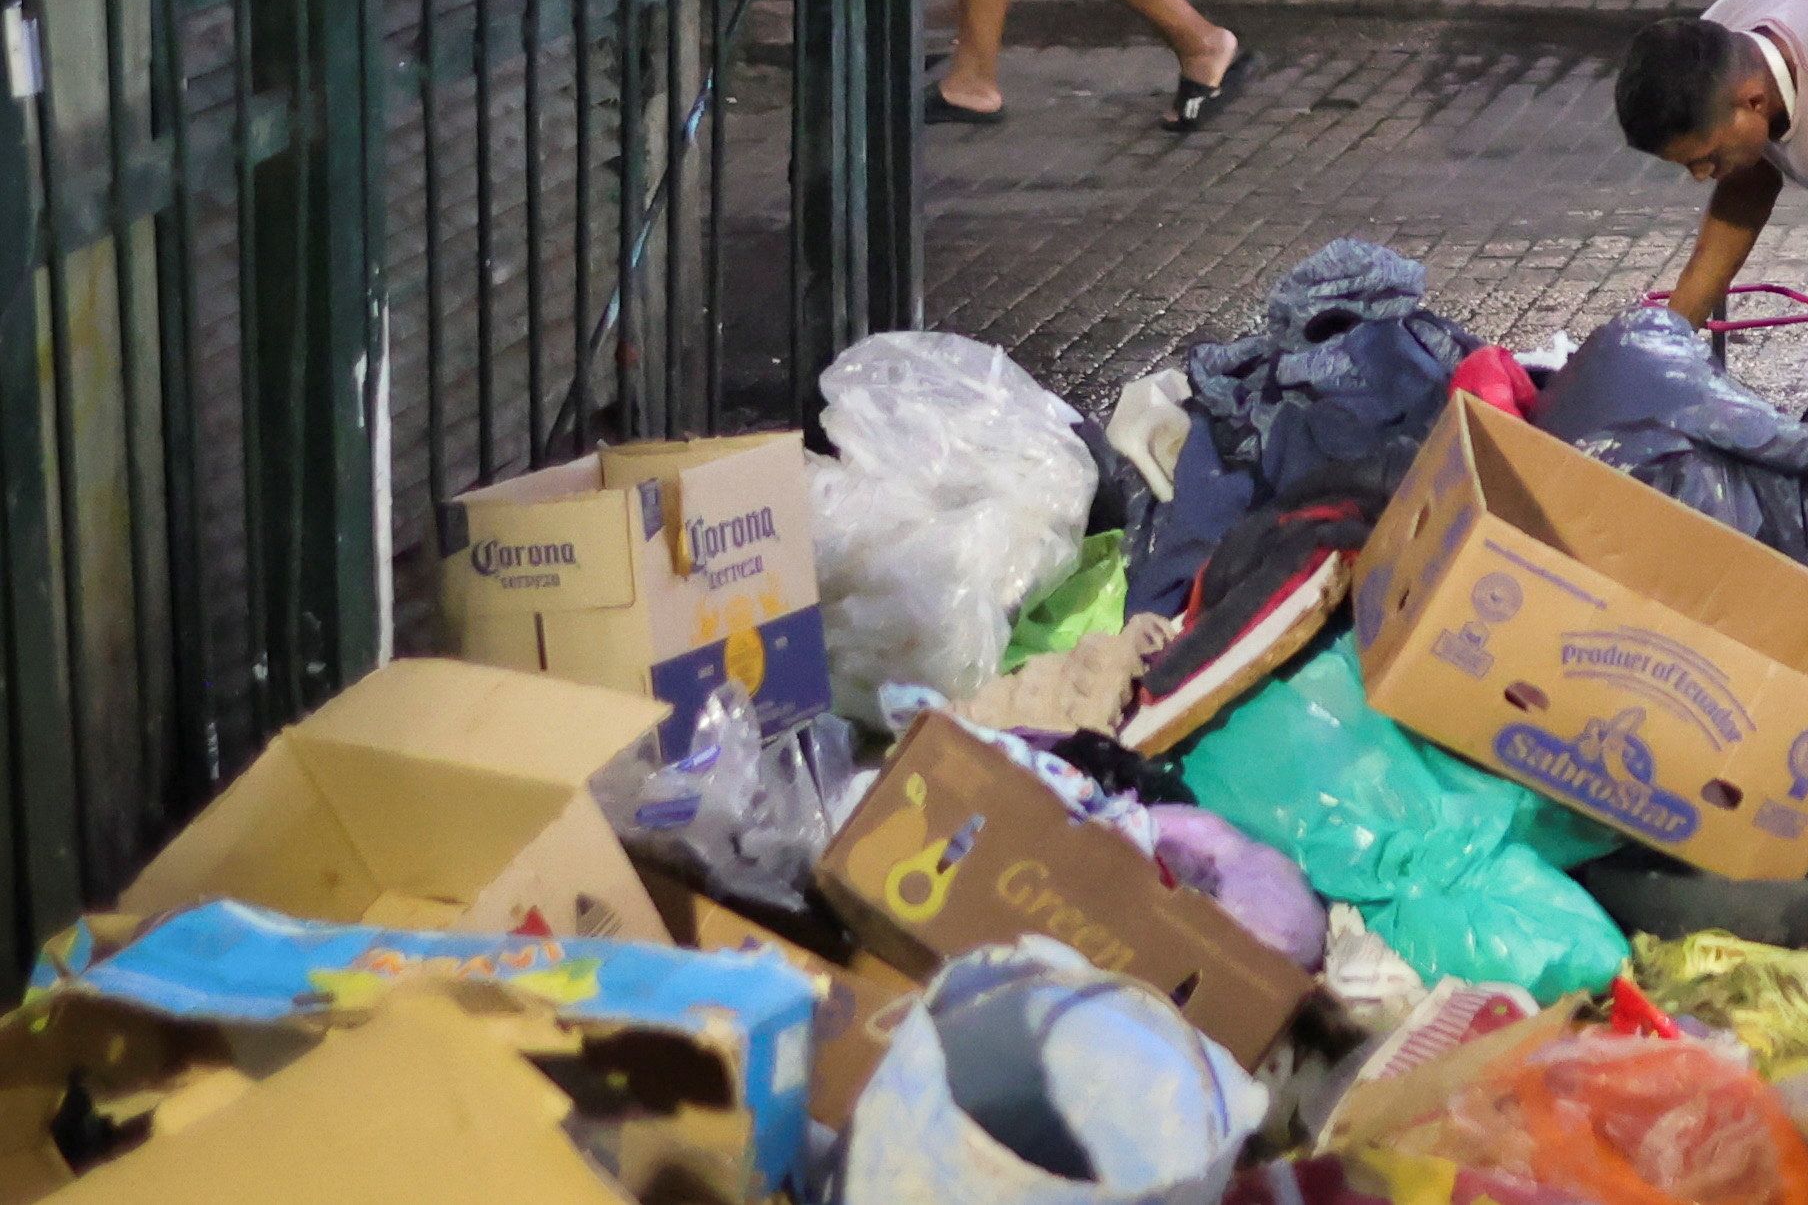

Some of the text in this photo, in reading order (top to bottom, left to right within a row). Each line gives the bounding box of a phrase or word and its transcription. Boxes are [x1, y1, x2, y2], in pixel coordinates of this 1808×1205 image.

[470, 539, 577, 576] Corona
[687, 506, 776, 574] Corona
[1562, 644, 1651, 672] Product
[1652, 661, 1678, 682] of
[998, 859, 1136, 973] Green
